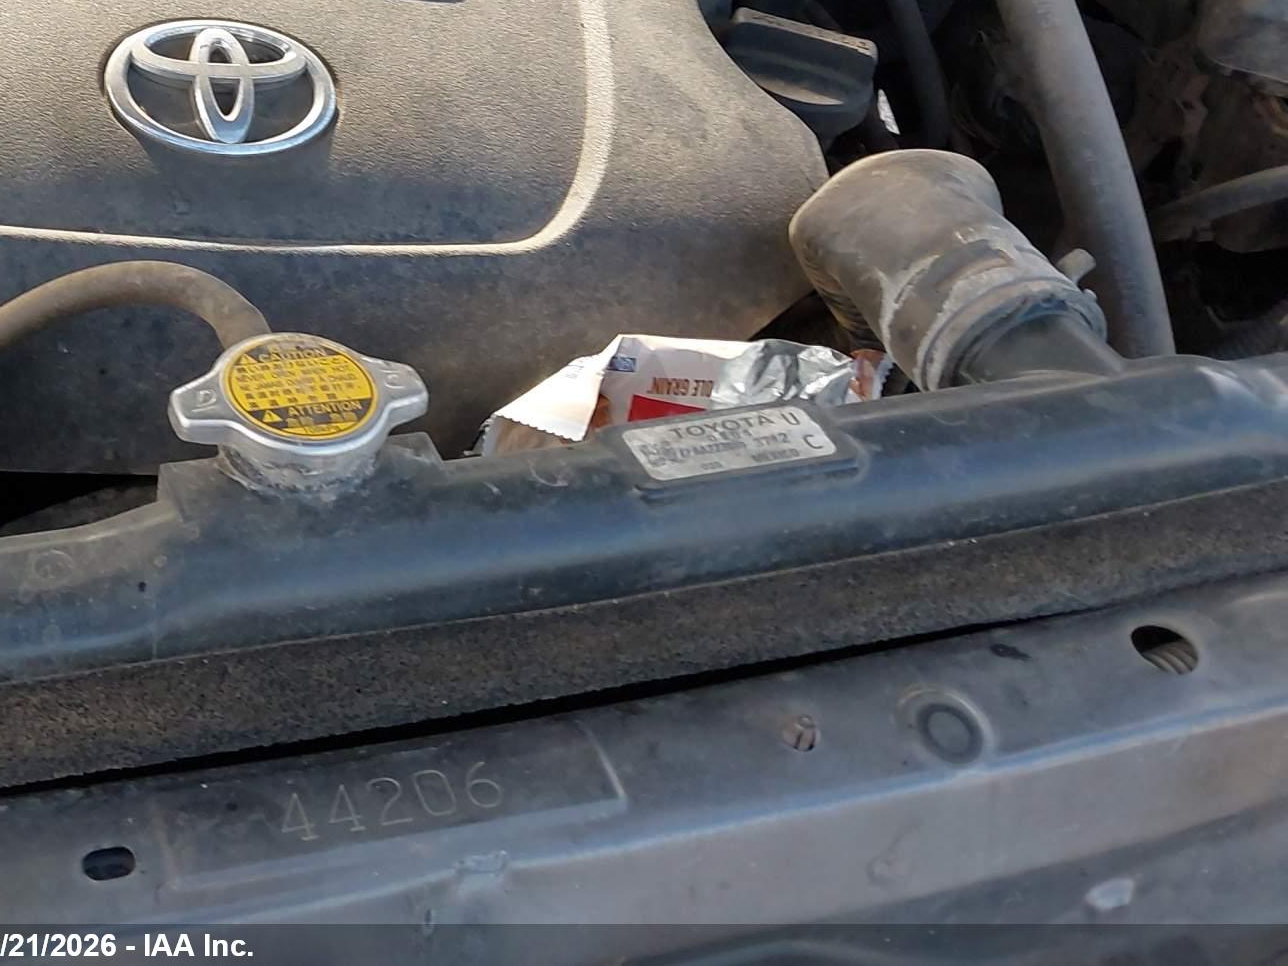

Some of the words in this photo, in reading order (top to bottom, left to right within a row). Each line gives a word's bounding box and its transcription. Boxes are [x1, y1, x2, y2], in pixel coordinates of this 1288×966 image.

[258, 348, 327, 363] CAUTION
[287, 400, 363, 418] ATTENTION
[670, 414, 775, 439] TOYOTA
[780, 411, 801, 426] U
[803, 434, 824, 450] C
[280, 761, 504, 841] 44206
